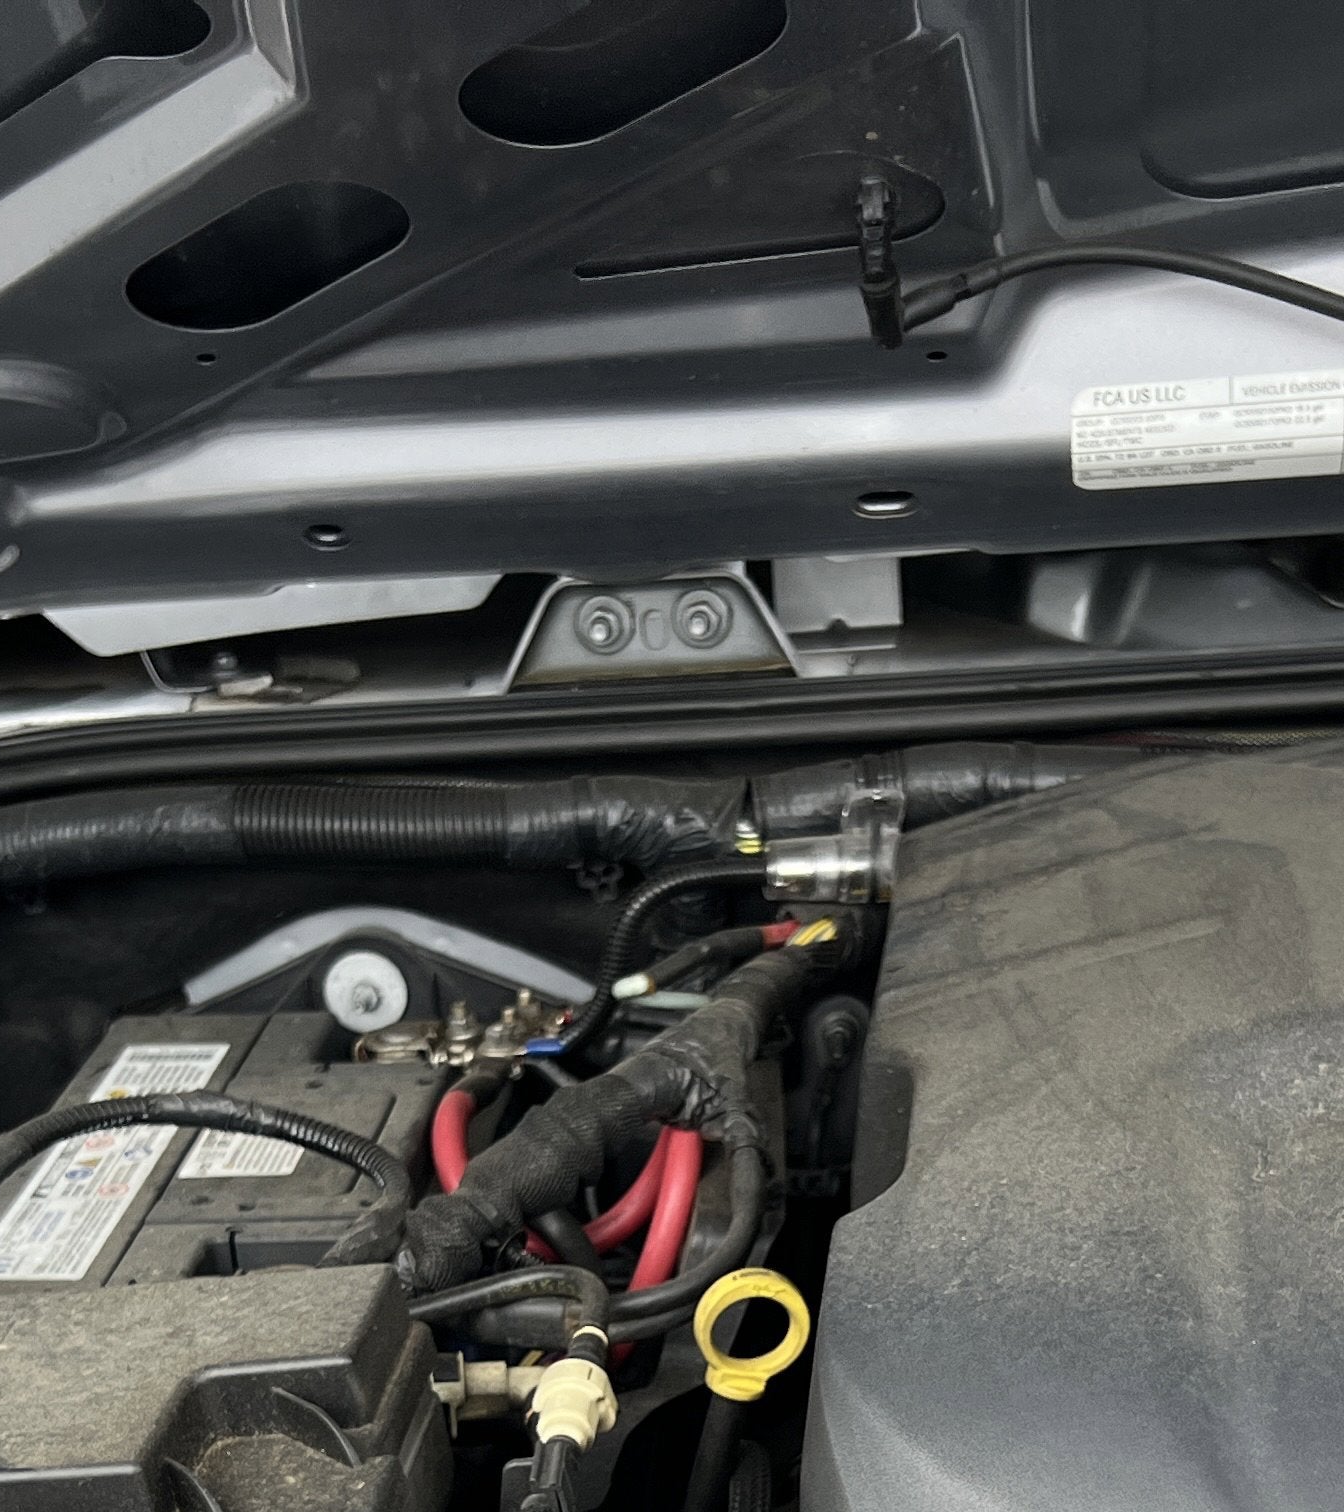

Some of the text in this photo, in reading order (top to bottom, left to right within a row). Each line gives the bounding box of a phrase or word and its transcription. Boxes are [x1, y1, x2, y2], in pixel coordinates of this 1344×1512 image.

[1092, 384, 1186, 407] FCA US LLC
